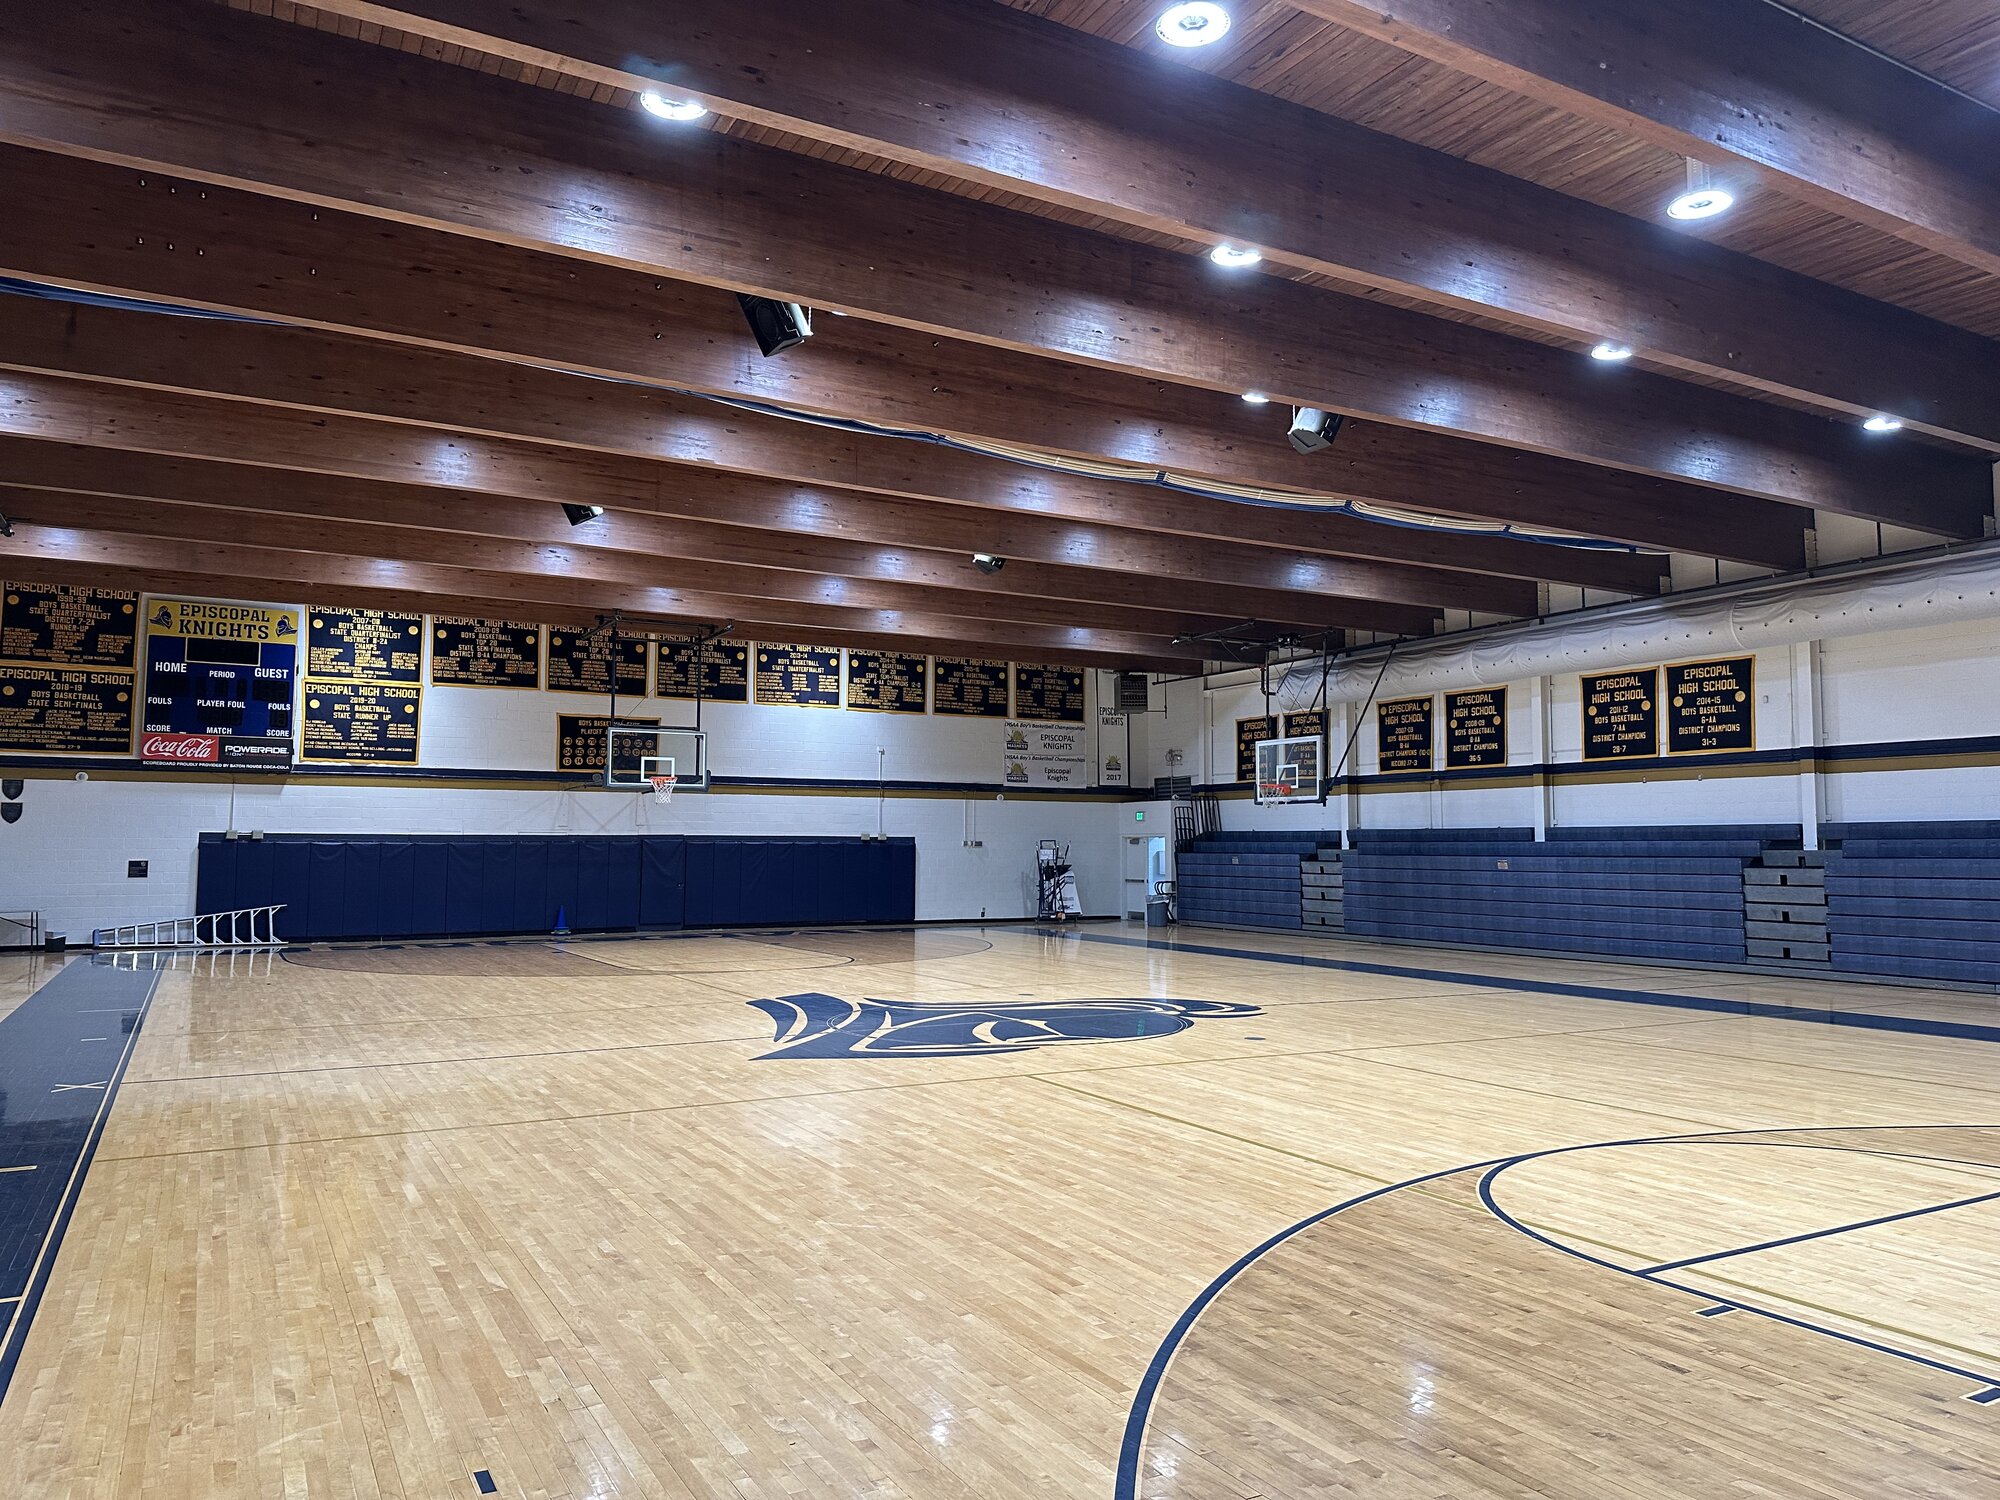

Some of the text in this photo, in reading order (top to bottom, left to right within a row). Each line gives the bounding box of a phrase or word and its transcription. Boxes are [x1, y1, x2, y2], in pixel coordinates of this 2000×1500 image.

[6, 581, 136, 600] EPISCOPAL HIGH SCHOOL
[61, 603, 102, 612] BASKETBALL
[310, 605, 421, 620] EPISCOPAL HIGH SCHOOL
[52, 609, 111, 620] QUARTERFINALIST
[180, 604, 269, 622] EPISCOPAL
[45, 616, 75, 624] DISTRICT
[434, 616, 480, 626] EPISCOPAL
[507, 622, 538, 630] SCHOOL
[50, 623, 89, 631] RUNNER-UP
[179, 619, 268, 639] KNIGHTS
[357, 624, 393, 632] BASKETBALL
[351, 630, 401, 639] QUARTERFINALIST
[478, 633, 511, 641] BASKETBALL
[758, 642, 793, 651] EPISCOPAL
[155, 662, 288, 679] HOME GUEST
[209, 670, 235, 678] PERIOD
[1684, 665, 1732, 679] EPISCOPAL
[0, 669, 132, 685] EPISCOPAL HIGH SCHOOL
[51, 683, 82, 691] 2018-19
[1597, 676, 1641, 690] EPISCOPAL
[1679, 679, 1739, 694] HIGH SCHOOL
[306, 684, 418, 698] EPISCOPAL HIGH SCHOOL
[54, 692, 99, 701] BASKETBALL
[1457, 694, 1493, 705] EPISCOPAL
[1592, 689, 1646, 704] HIGH SCHOOL
[1697, 696, 1720, 705] 2014-15
[54, 701, 102, 709] SEMI-FINALS
[355, 705, 390, 713] BASKETBALL
[1389, 703, 1421, 713] EPISCOPAL
[1699, 705, 1736, 714] BASKETBALL
[1453, 706, 1497, 718] HIGH SCHOOL
[1102, 718, 1123, 726] KNIGHTS
[1385, 714, 1424, 725] HIGH SCHOOL
[1595, 714, 1643, 724] BOYS BASKETBALL
[266, 729, 289, 737] SCORE
[1468, 727, 1495, 735] BASKETBALL
[1679, 724, 1740, 735] DISTRICT CHAMPIONS
[1041, 734, 1075, 742] EPISCOPAL
[1593, 732, 1646, 742] DISTRICT CHAMPIONS
[1702, 738, 1716, 746] 31-3
[143, 736, 216, 758] Coca-Cola
[1474, 743, 1498, 751] CHAMPIONS
